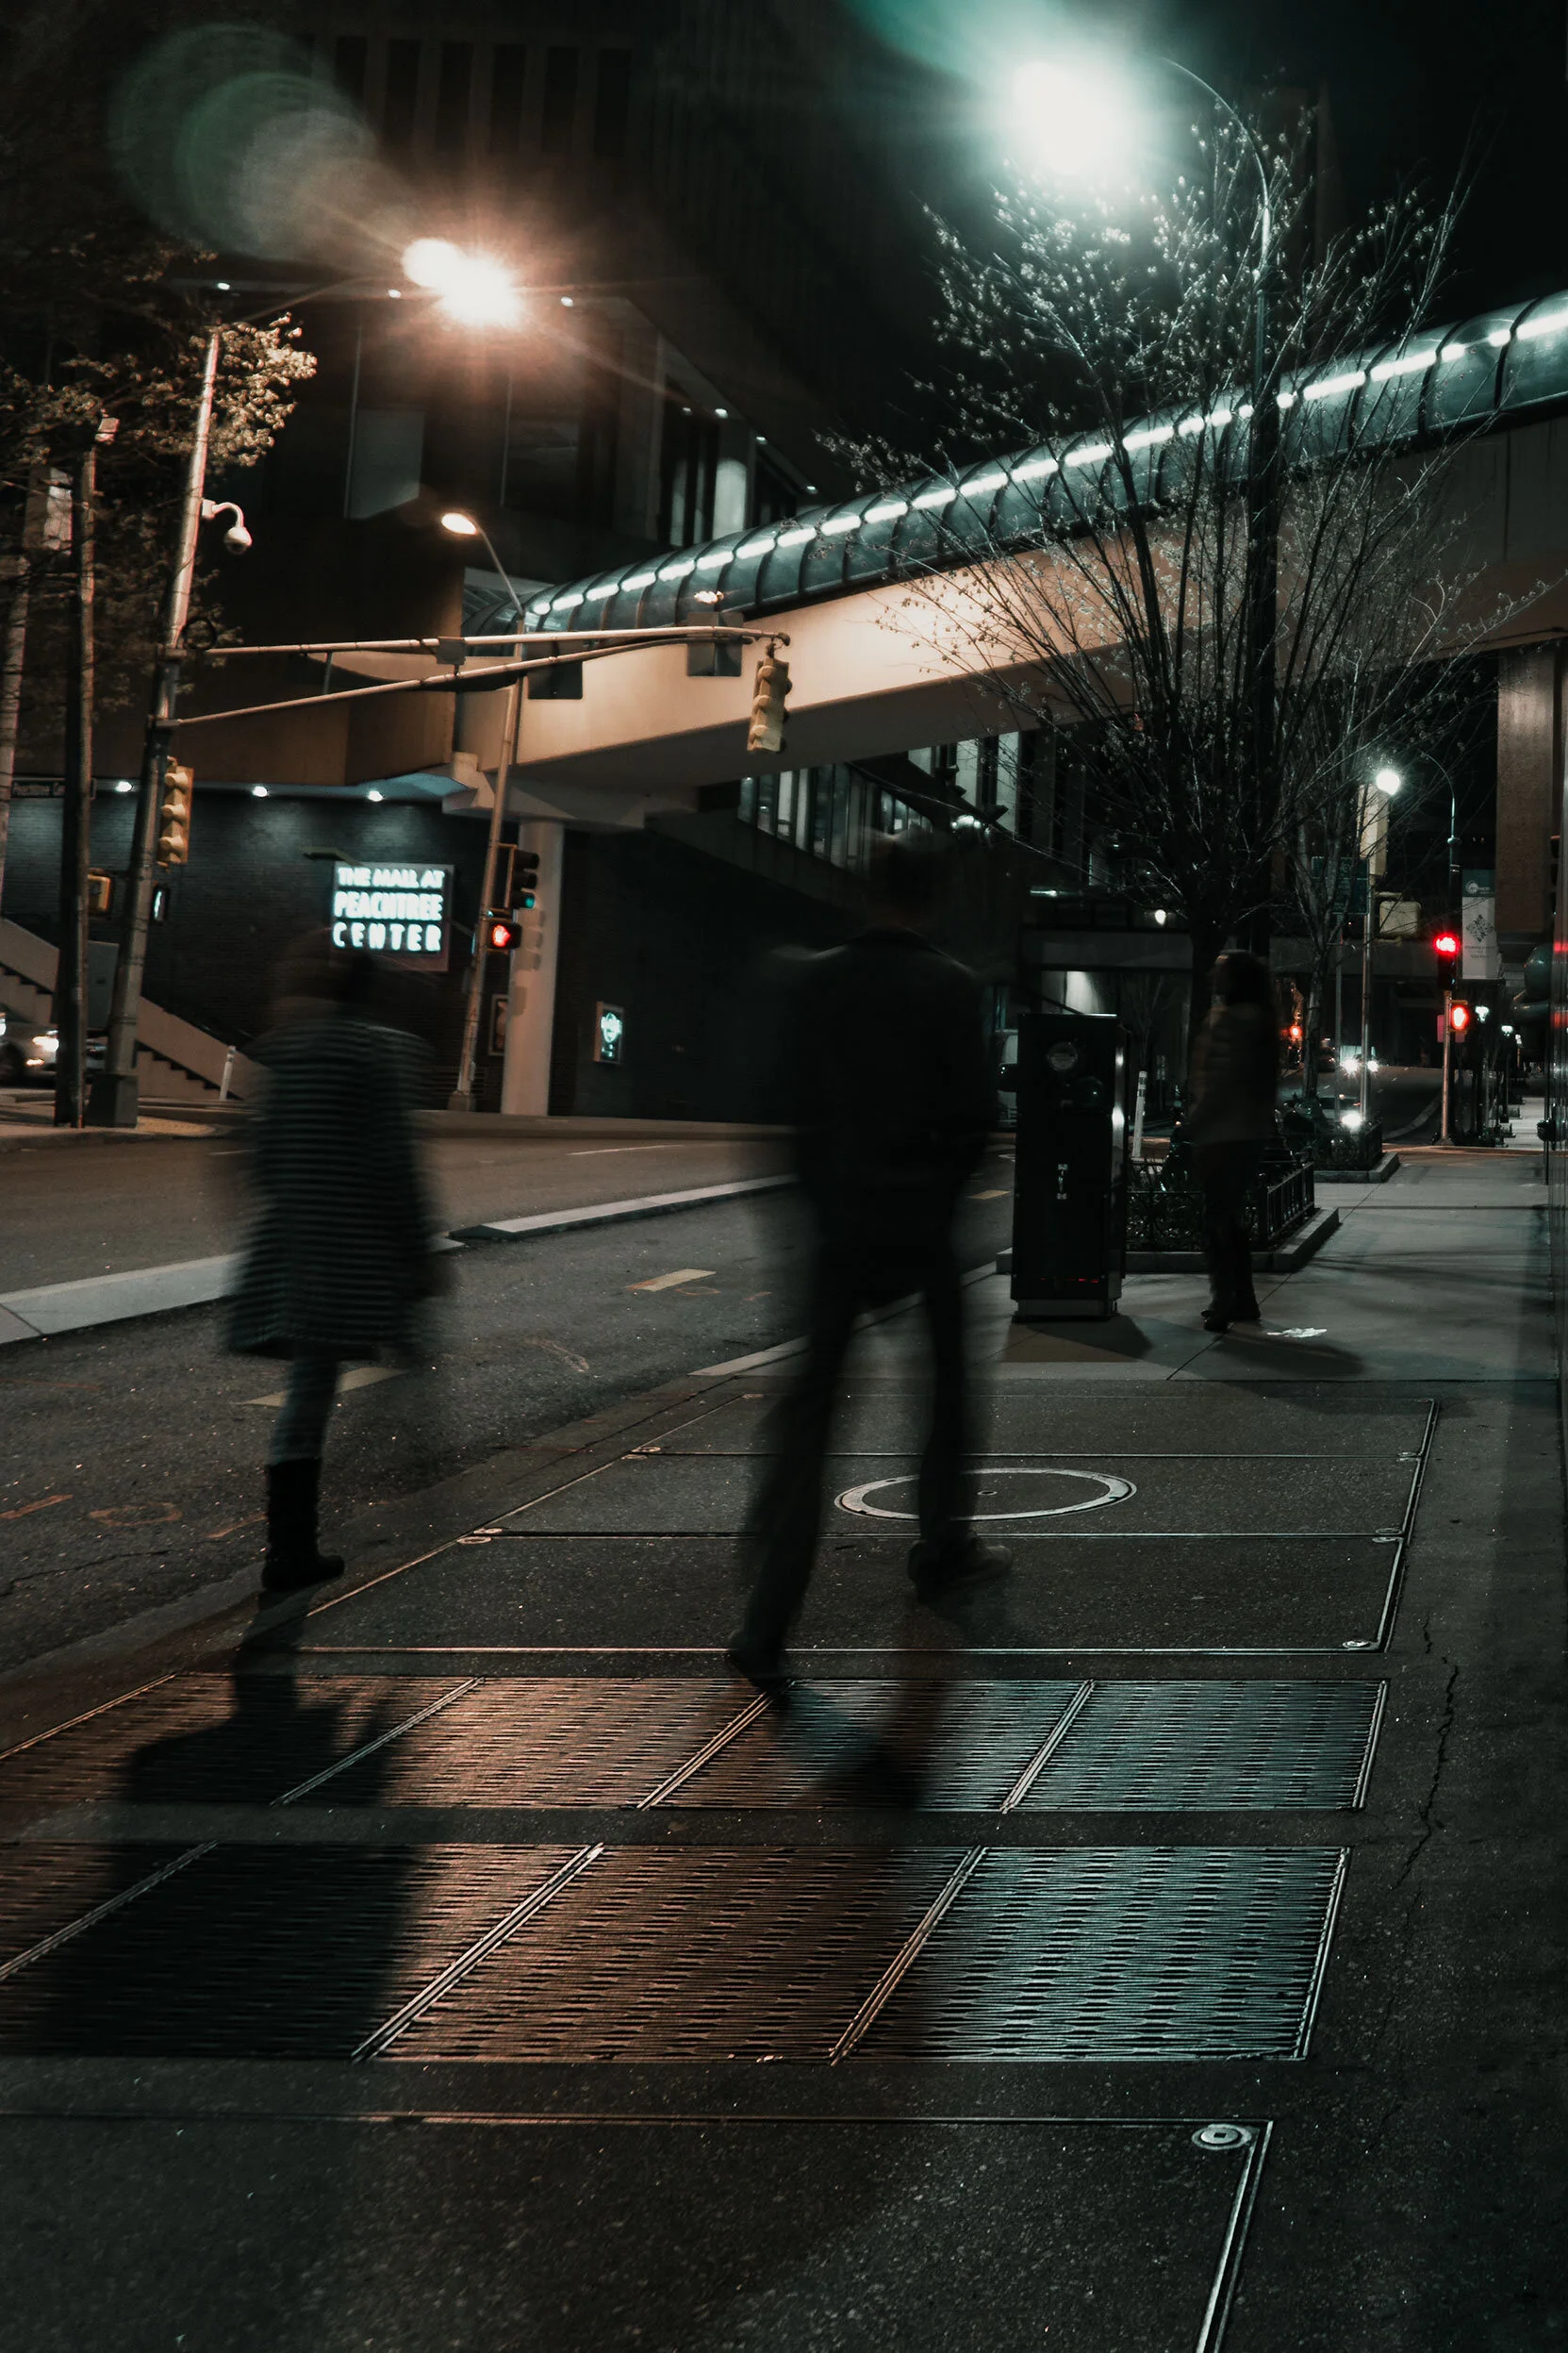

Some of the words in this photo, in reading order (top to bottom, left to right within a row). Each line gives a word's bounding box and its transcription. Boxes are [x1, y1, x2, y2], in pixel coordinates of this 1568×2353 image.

[338, 866, 371, 887] THE
[371, 868, 420, 888] MALL
[420, 869, 445, 888] AT
[333, 890, 444, 921] PEACHTREE
[332, 921, 442, 952] CENTER
